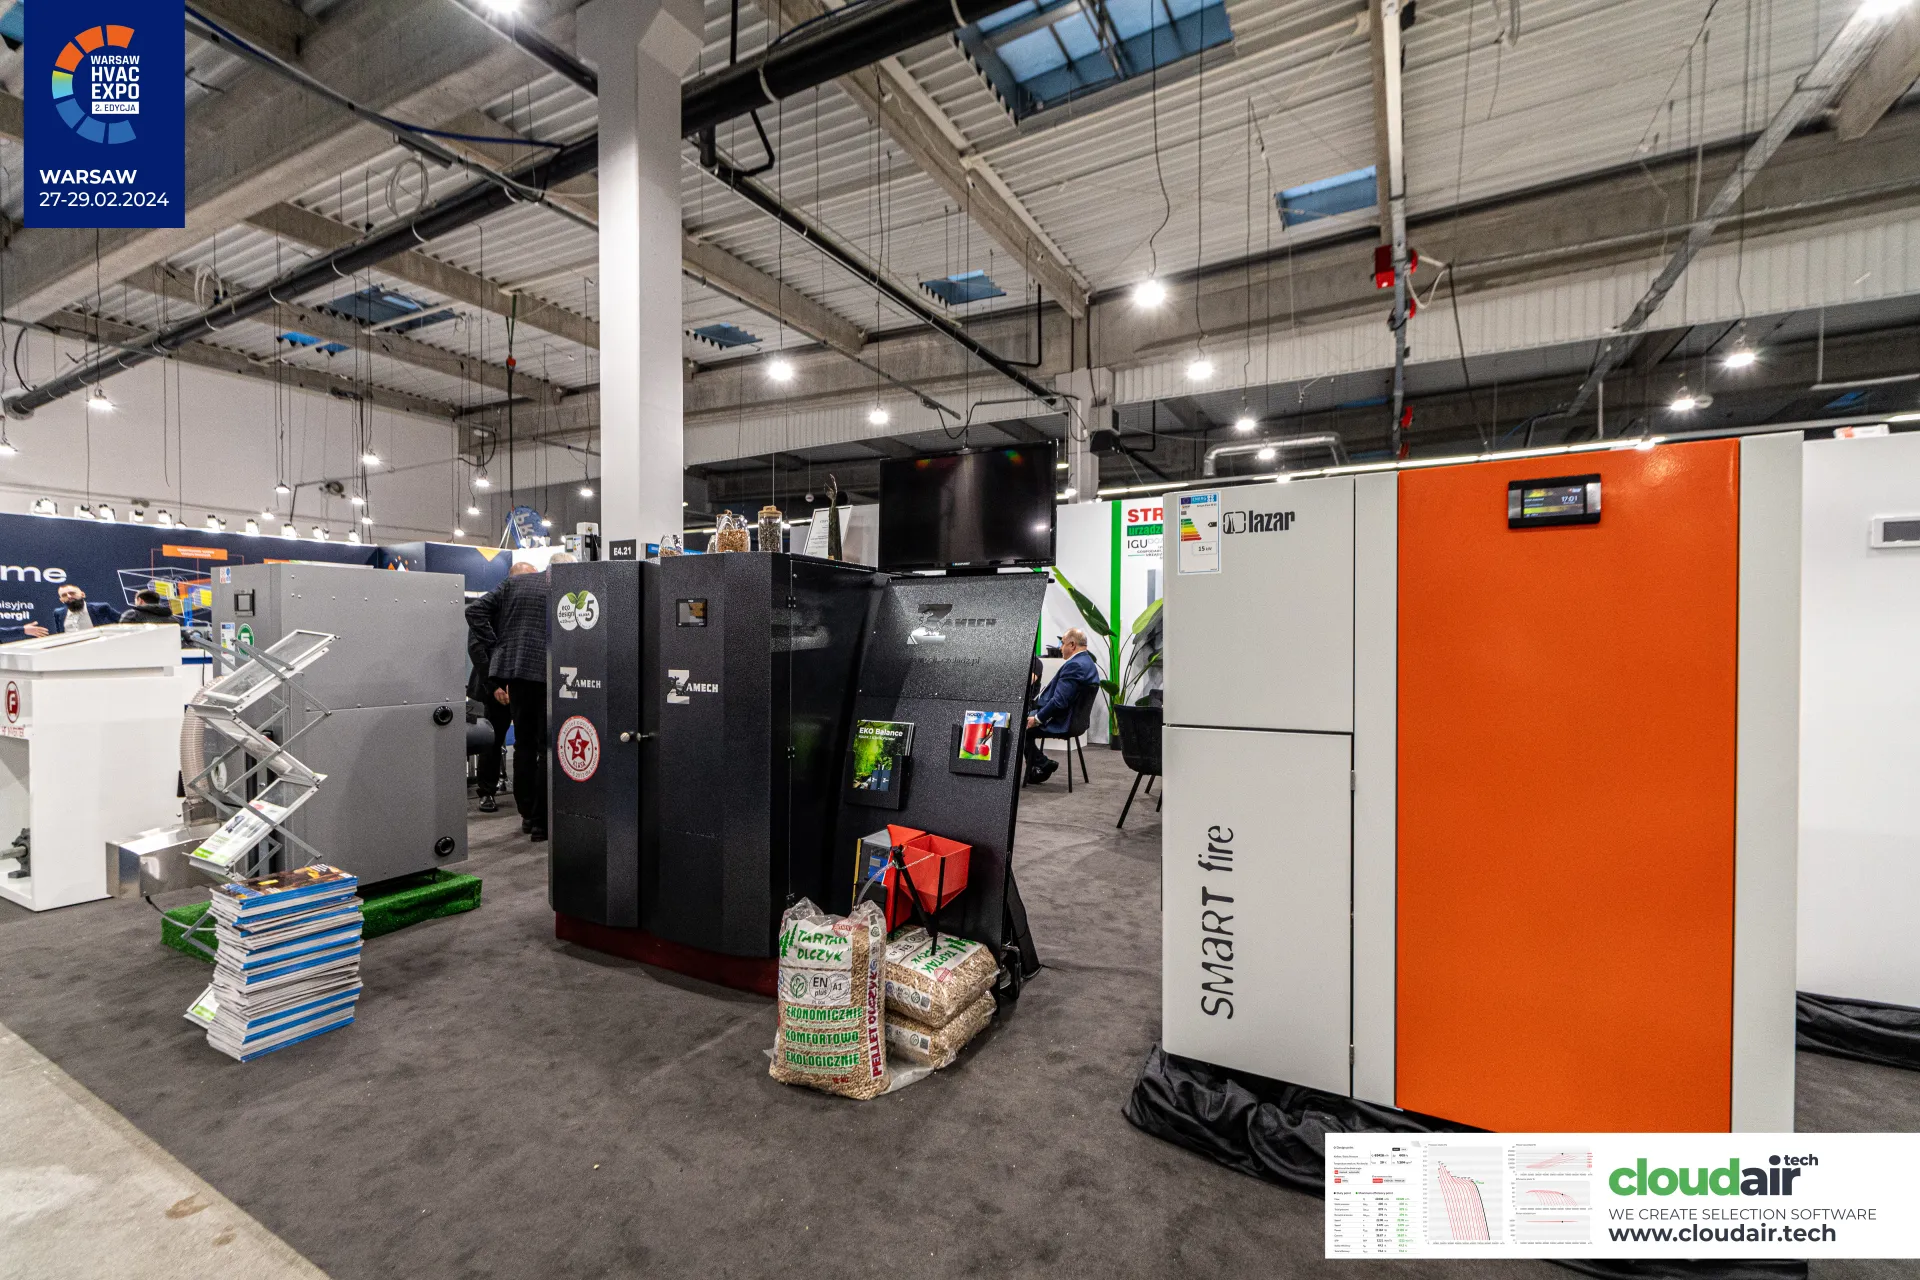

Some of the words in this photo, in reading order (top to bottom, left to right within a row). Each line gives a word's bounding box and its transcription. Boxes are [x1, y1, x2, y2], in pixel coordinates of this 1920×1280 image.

[1561, 495, 1578, 503] 17:01
[1248, 510, 1296, 533] lazar
[1129, 524, 1163, 536] urządz
[613, 546, 632, 557] E4.21
[1127, 539, 1148, 549] IGU
[558, 611, 575, 619] design
[585, 599, 595, 622] 5
[559, 666, 601, 700] ZAMECH
[666, 669, 719, 705] ZAMECH
[859, 727, 874, 735] EKO
[875, 728, 904, 737] Balance
[574, 738, 582, 755] 5
[1197, 825, 1235, 872] fire
[812, 976, 828, 988] EN
[832, 983, 843, 991] A1
[814, 989, 827, 998] plus
[786, 1005, 863, 1021] EKONOMICZNIE
[785, 1028, 859, 1045] KOMFORTOWO
[785, 1050, 860, 1067] EKOLOGICZNIE
[868, 1028, 883, 1078] PELLET
